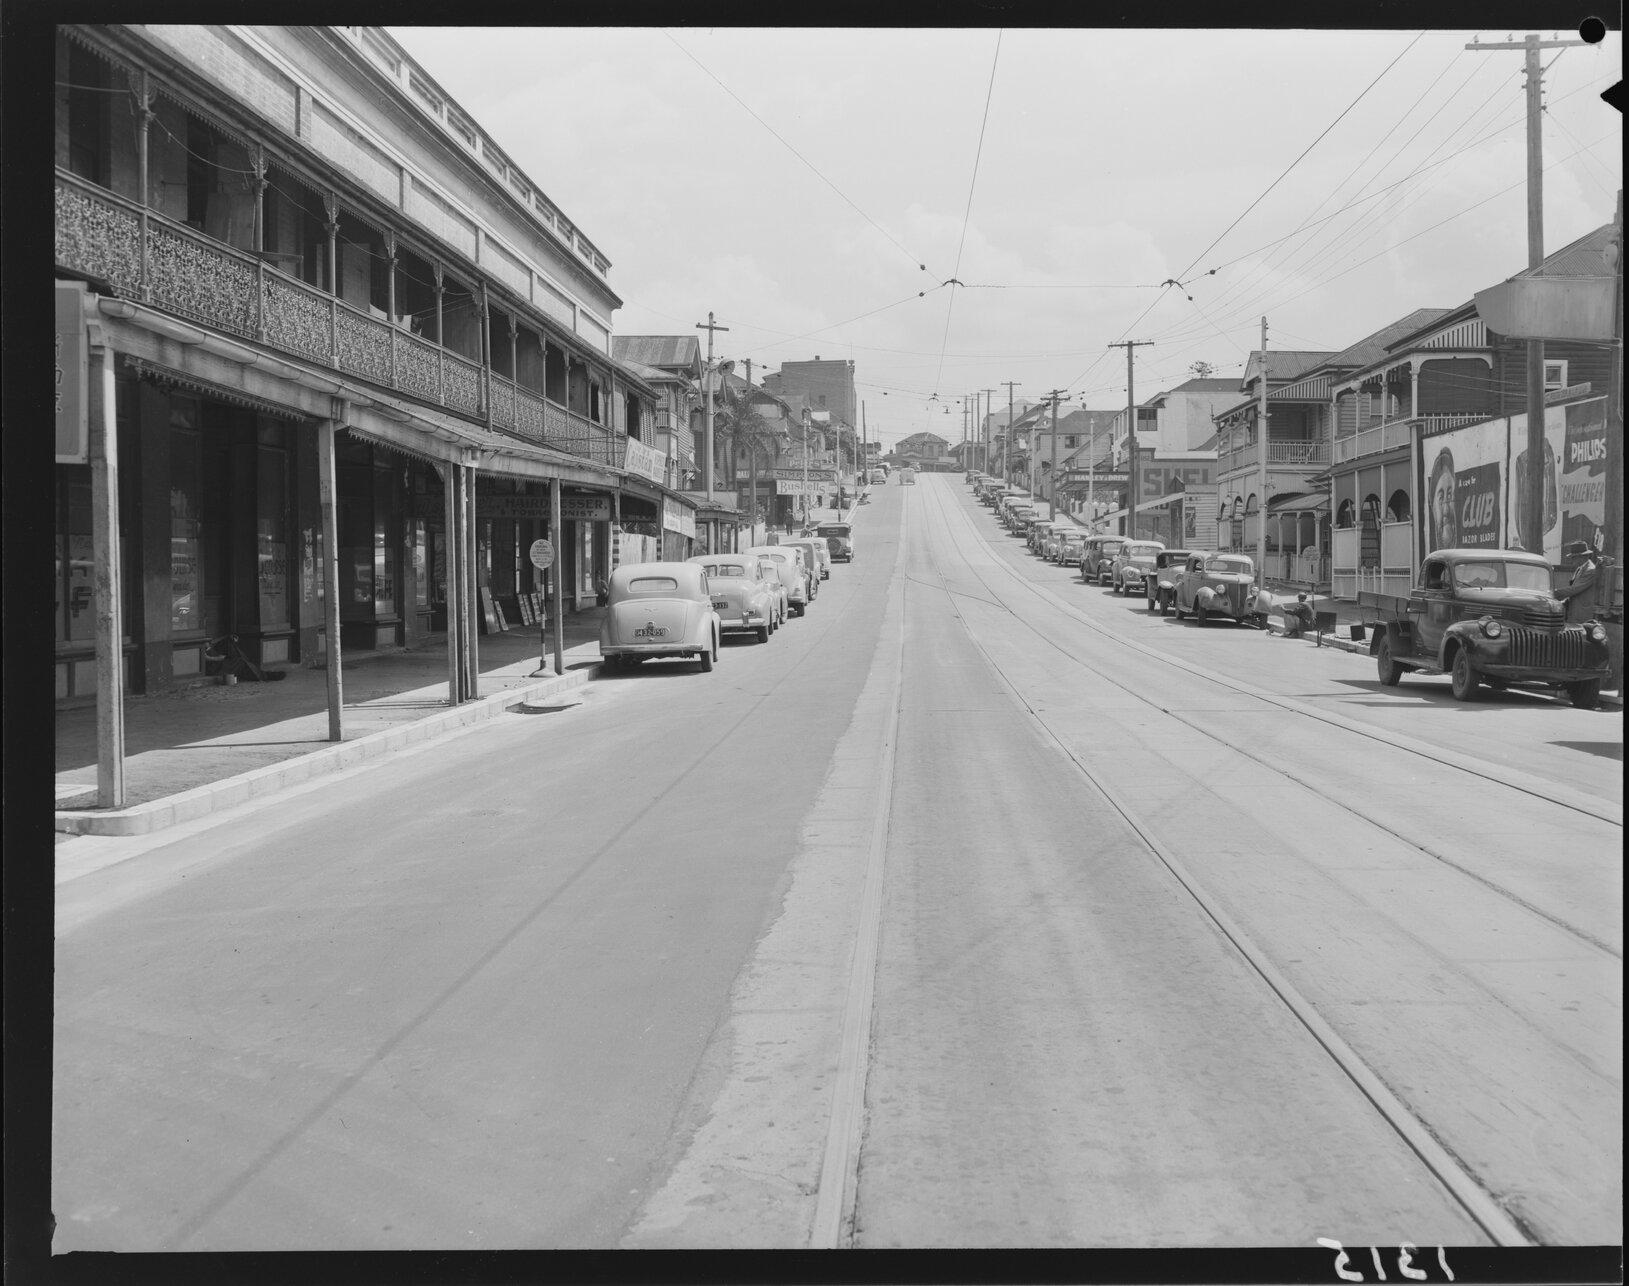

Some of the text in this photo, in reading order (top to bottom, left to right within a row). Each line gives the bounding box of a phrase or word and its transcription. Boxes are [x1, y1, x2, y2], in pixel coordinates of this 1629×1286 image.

[1571, 438, 1607, 463] PHILIPS
[776, 471, 832, 479] SIMPON'S
[505, 497, 608, 511] HAIRDESSER,
[1462, 491, 1495, 528] CLUB
[511, 509, 598, 517] TOBACONIST.
[1462, 531, 1496, 544] RAZOR BLADES
